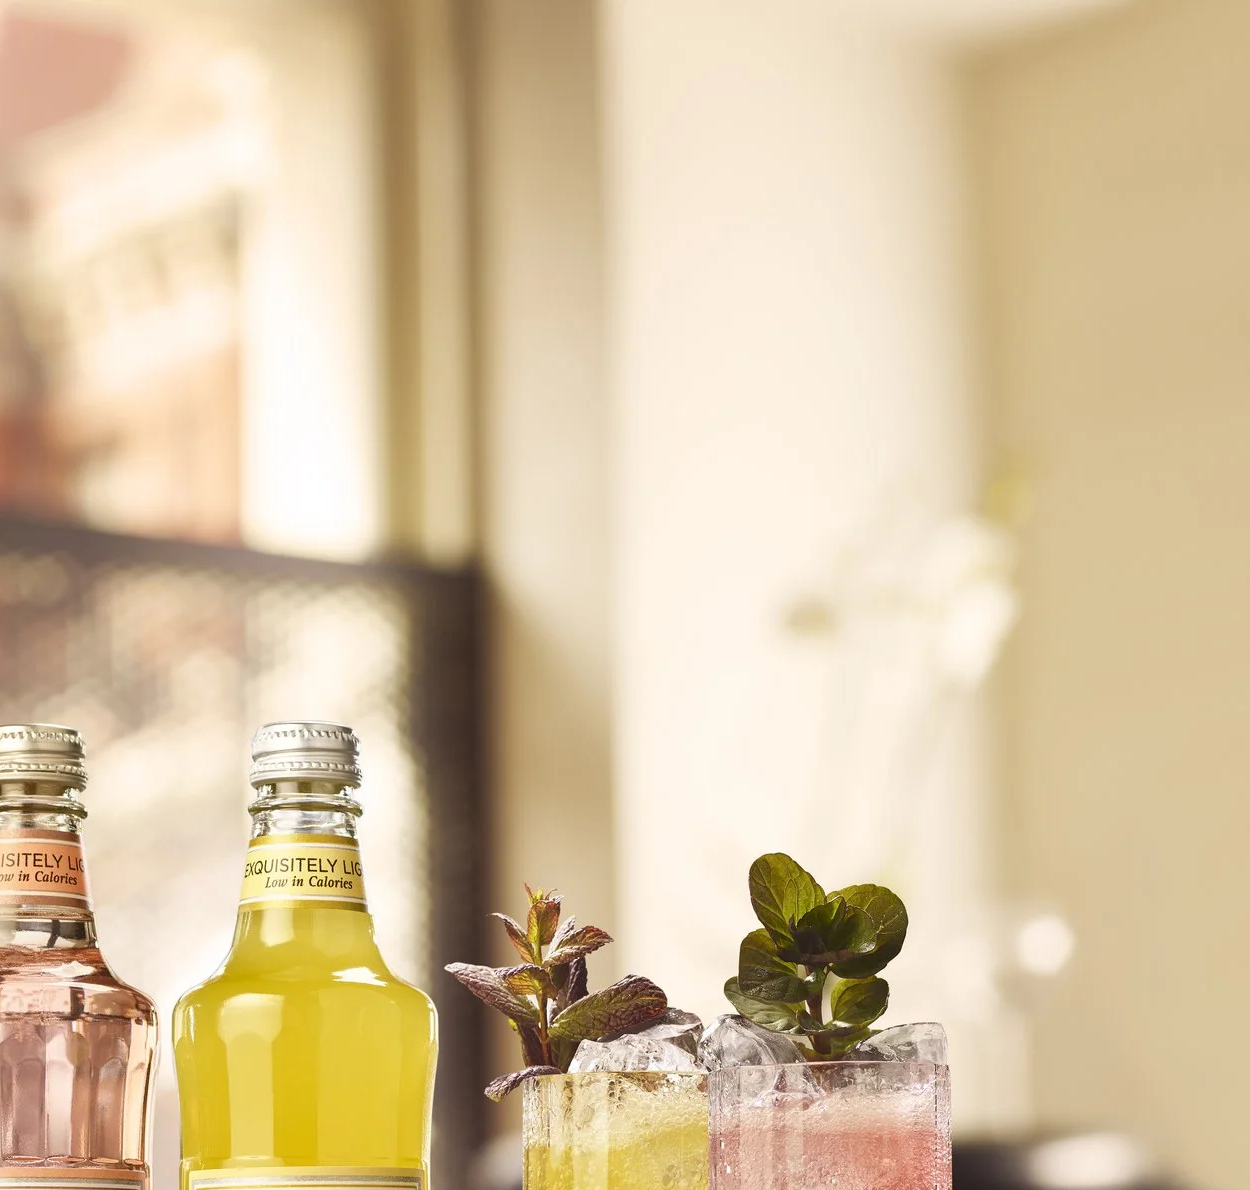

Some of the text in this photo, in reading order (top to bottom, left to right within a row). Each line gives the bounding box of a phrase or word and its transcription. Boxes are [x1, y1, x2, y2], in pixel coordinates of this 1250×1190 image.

[244, 857, 338, 878] EXQUISITELY
[18, 870, 30, 882] in
[34, 870, 78, 886] Calories
[264, 876, 353, 890] Low in Calories
